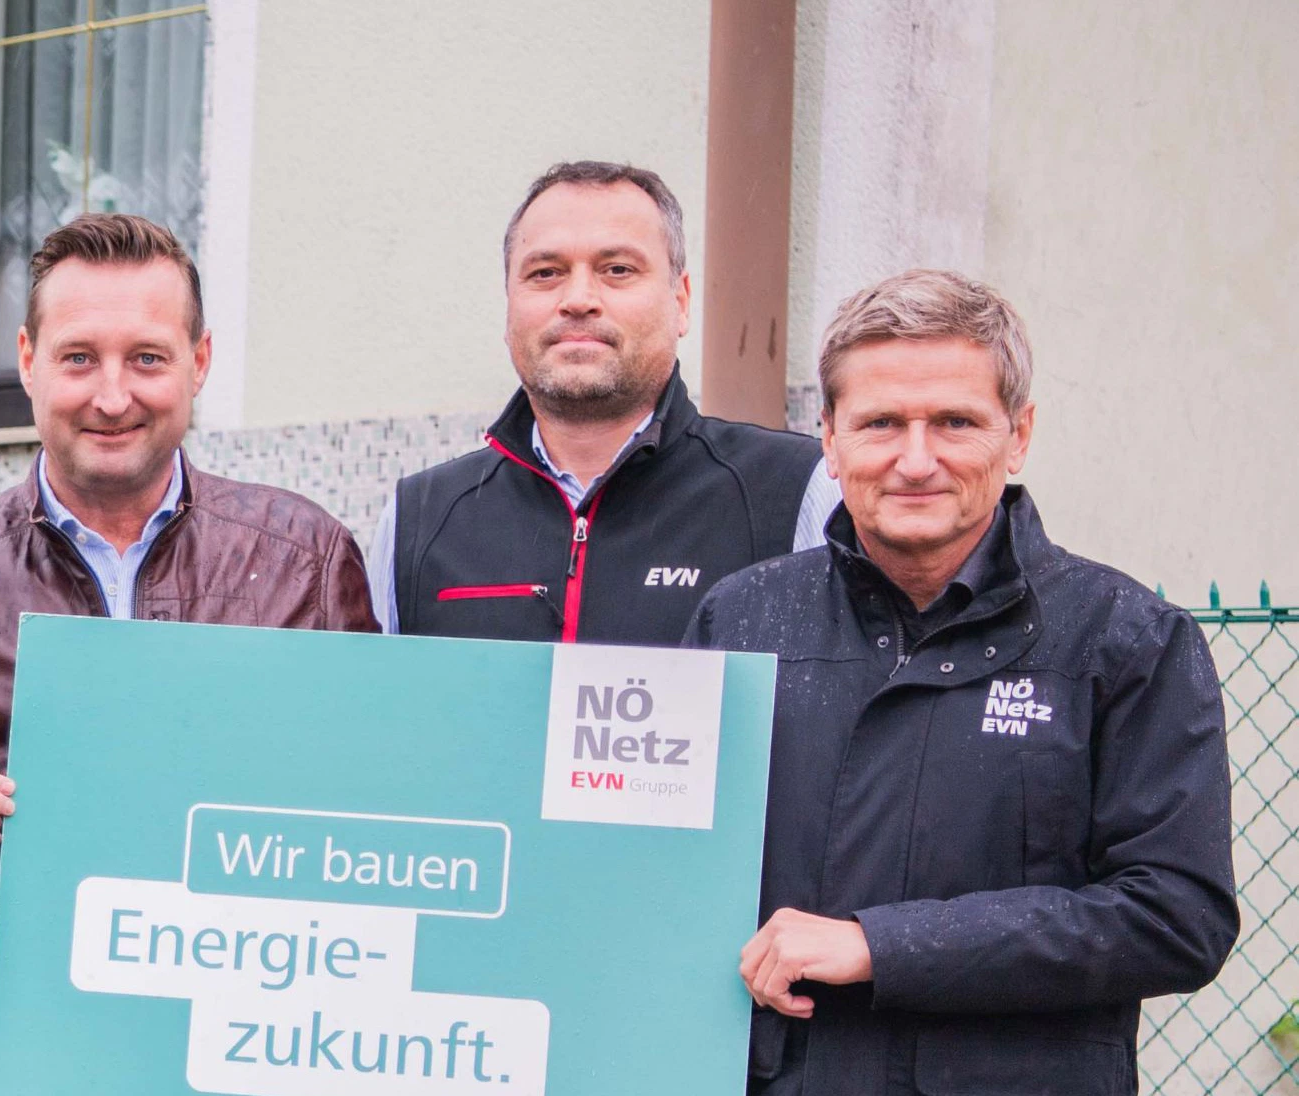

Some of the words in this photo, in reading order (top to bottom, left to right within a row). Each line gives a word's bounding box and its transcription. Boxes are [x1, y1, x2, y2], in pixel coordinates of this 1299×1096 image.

[644, 567, 701, 587] EVN
[576, 677, 654, 723] NÖ
[988, 678, 1035, 699] NÖ
[981, 717, 1028, 736] EVN
[984, 698, 1053, 722] Netz
[573, 725, 691, 766] Netz
[570, 770, 625, 791] EVN
[629, 778, 689, 797] Gruppe
[216, 832, 306, 879] Wir
[322, 835, 478, 892] bauen
[107, 908, 388, 990] Energie-
[224, 1010, 512, 1085] zukunft.
